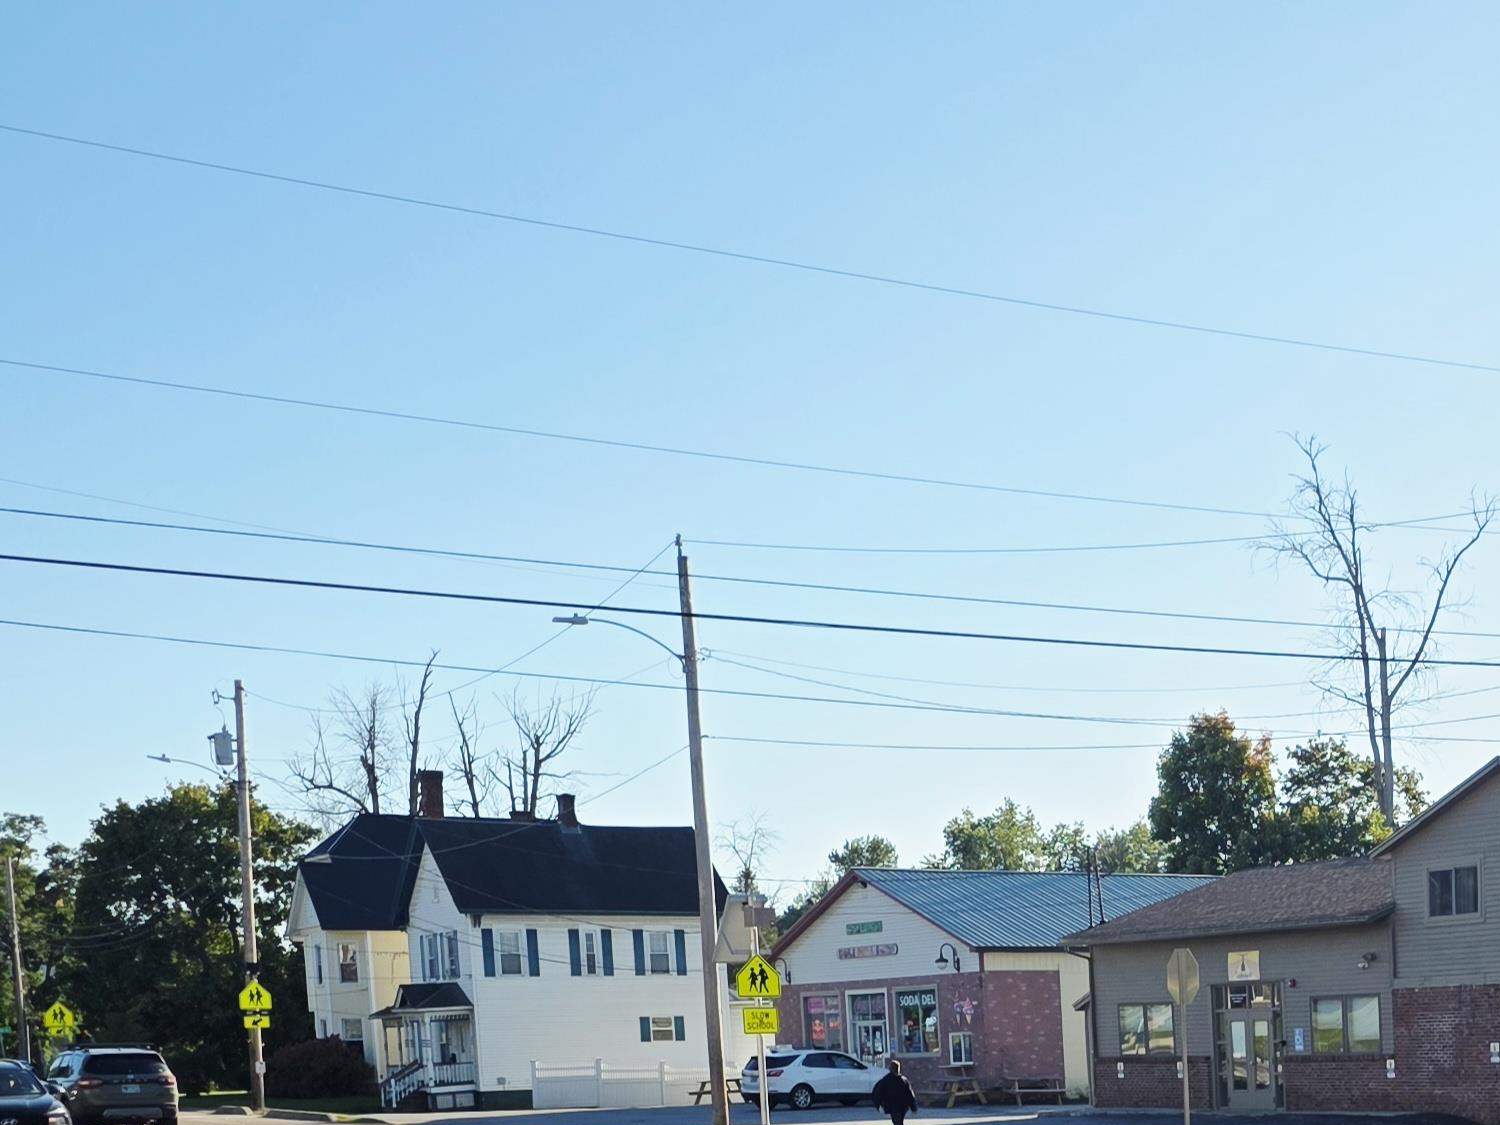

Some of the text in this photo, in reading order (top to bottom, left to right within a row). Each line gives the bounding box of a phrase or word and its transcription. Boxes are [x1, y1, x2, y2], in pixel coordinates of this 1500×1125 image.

[899, 994, 919, 1006] SODA
[751, 1011, 770, 1020] SLOW
[746, 1022, 776, 1030] SCHOOL
